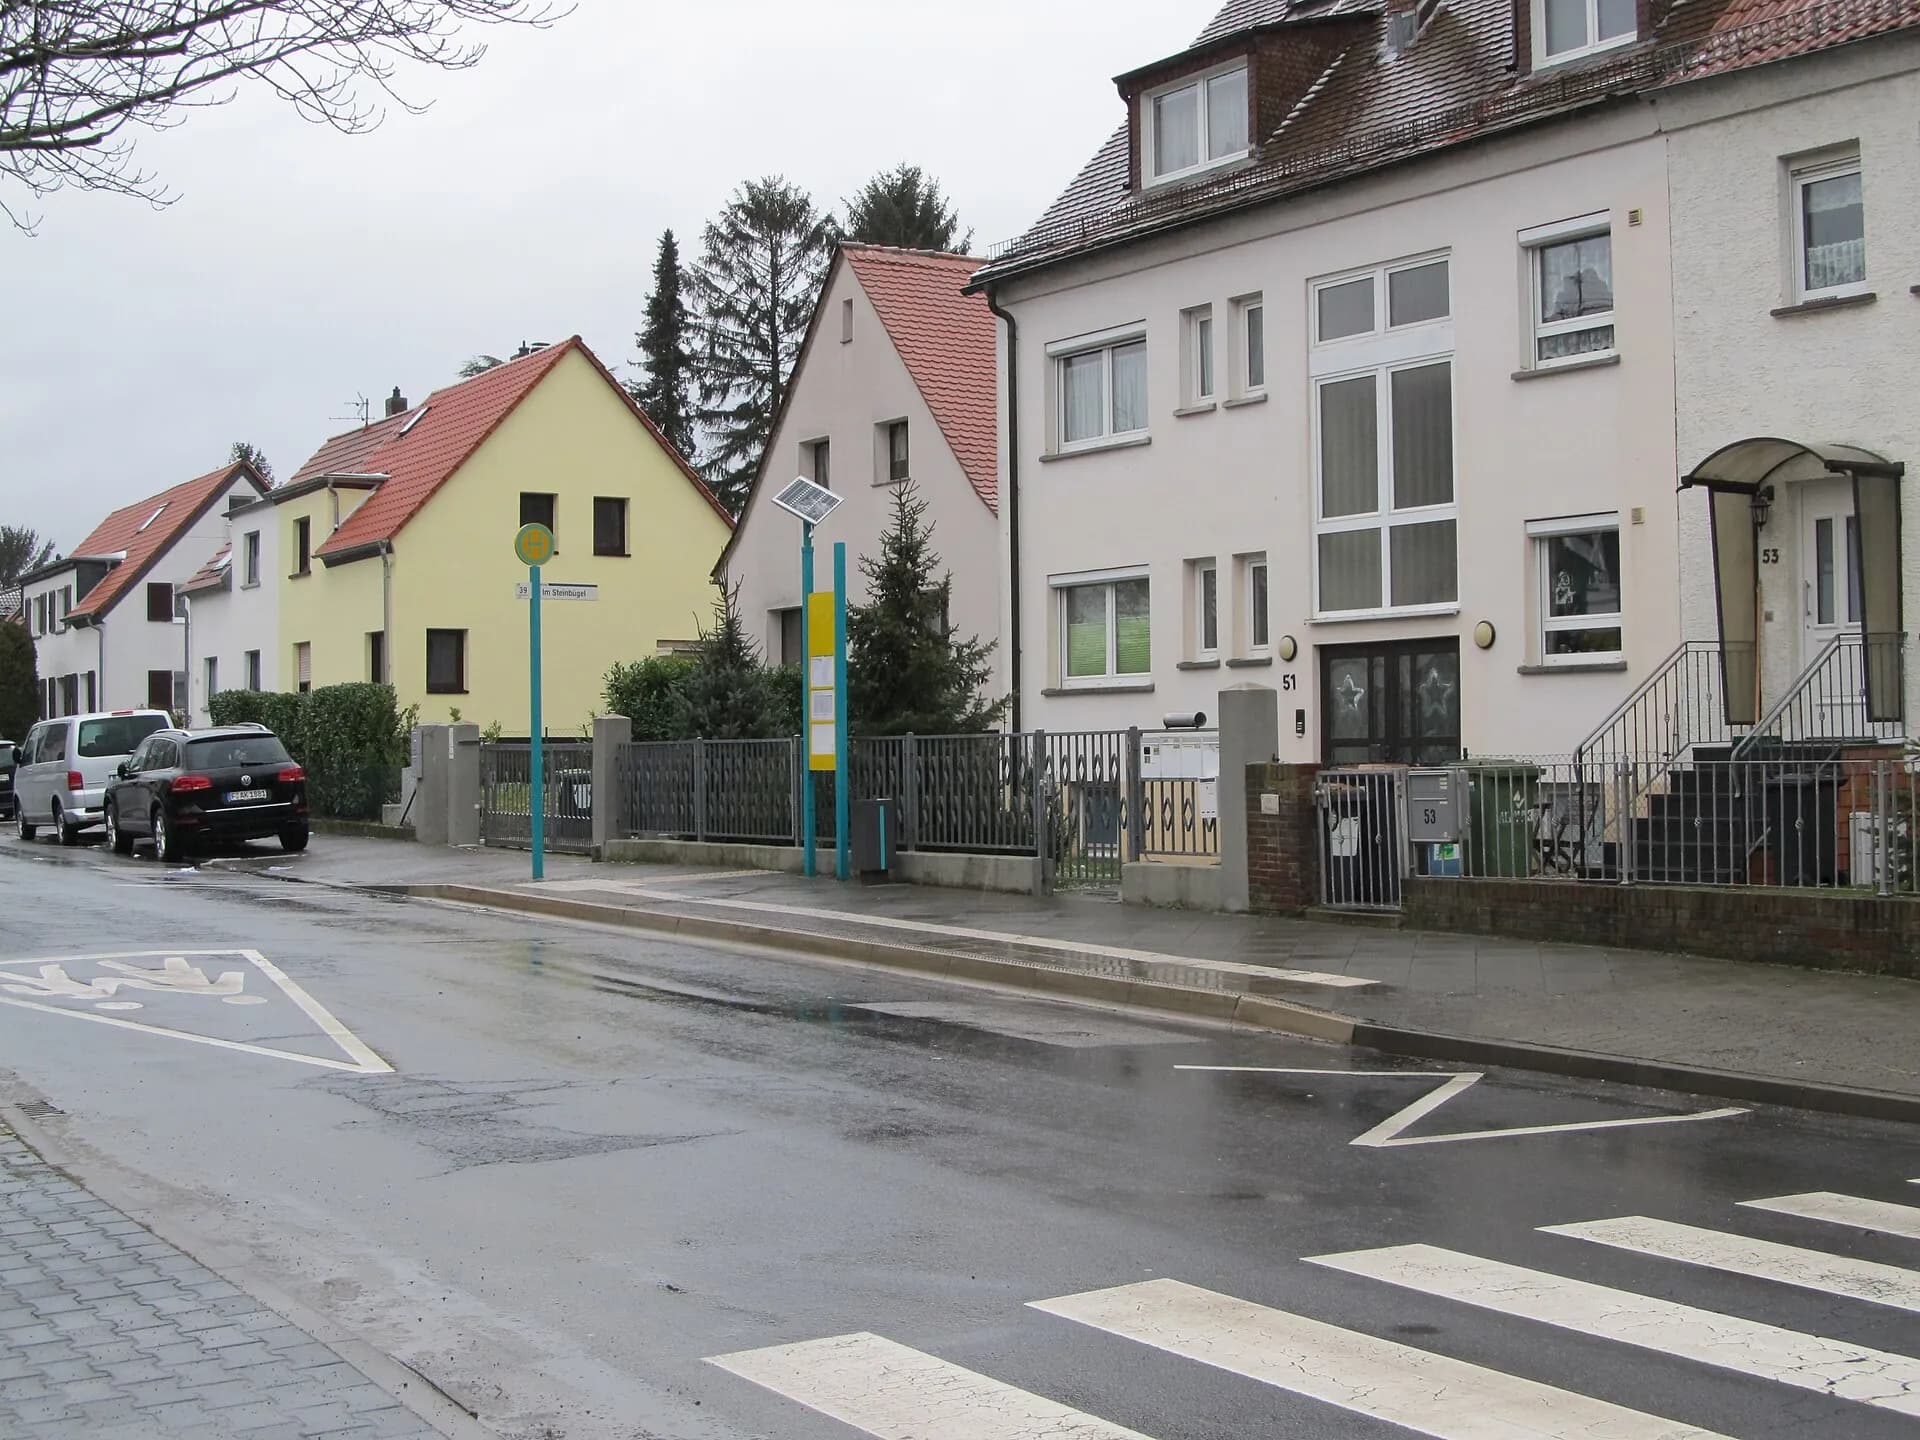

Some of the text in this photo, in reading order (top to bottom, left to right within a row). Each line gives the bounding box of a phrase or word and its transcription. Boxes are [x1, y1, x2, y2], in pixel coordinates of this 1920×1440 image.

[527, 531, 544, 558] H
[1762, 549, 1779, 564] 53
[542, 588, 551, 596] Im
[1283, 673, 1296, 691] 51
[1424, 809, 1436, 824] 53
